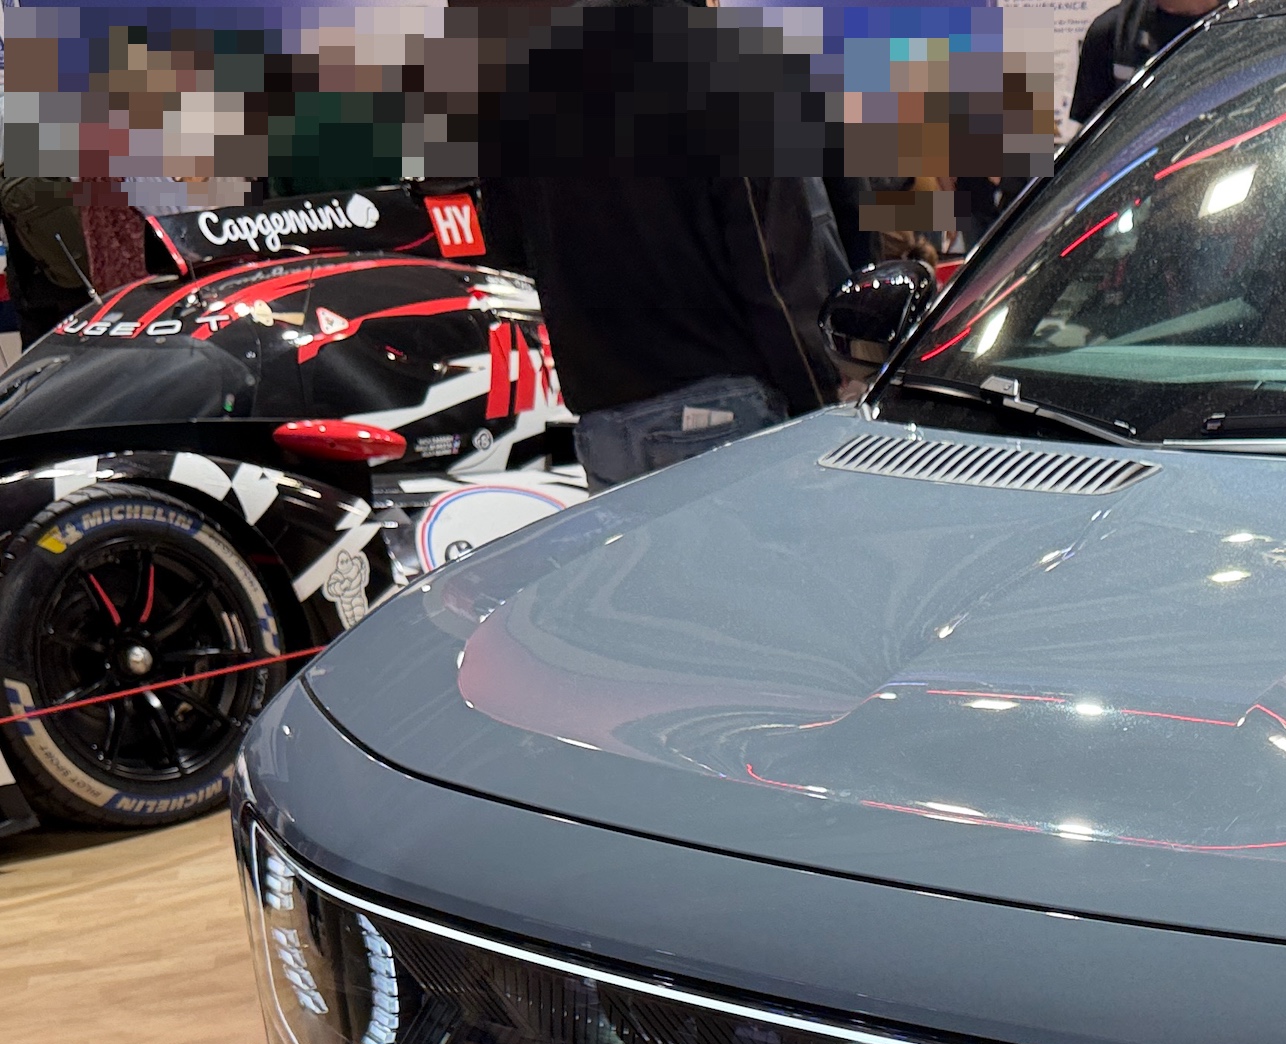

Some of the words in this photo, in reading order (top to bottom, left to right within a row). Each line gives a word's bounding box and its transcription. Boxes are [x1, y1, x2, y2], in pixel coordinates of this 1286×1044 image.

[199, 199, 353, 252] Capgemini
[433, 205, 474, 246] HY
[57, 314, 229, 337] UGEOT
[81, 504, 194, 531] MICHELIN
[116, 777, 224, 813] MICHELIN
